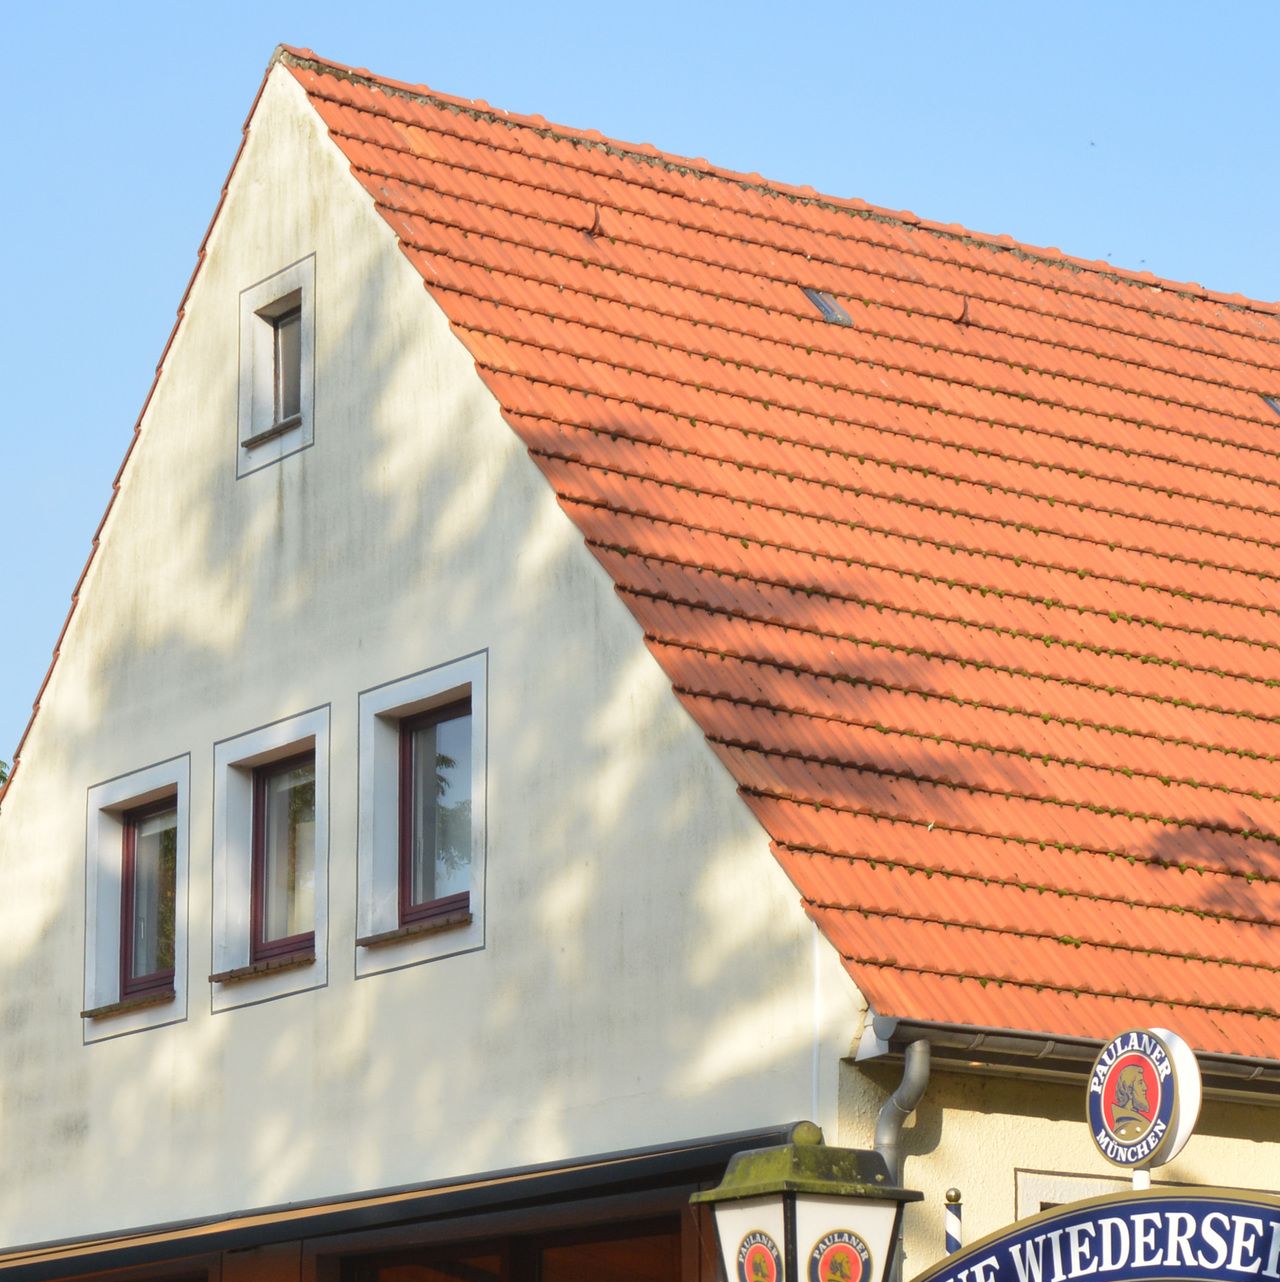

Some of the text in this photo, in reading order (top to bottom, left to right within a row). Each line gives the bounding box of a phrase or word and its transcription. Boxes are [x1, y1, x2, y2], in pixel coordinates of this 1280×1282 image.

[1090, 1032, 1172, 1095] PAULANER
[1096, 1119, 1166, 1162] MÜNCHEN
[738, 1233, 778, 1263] PAULANER
[813, 1232, 869, 1261] PAULANER
